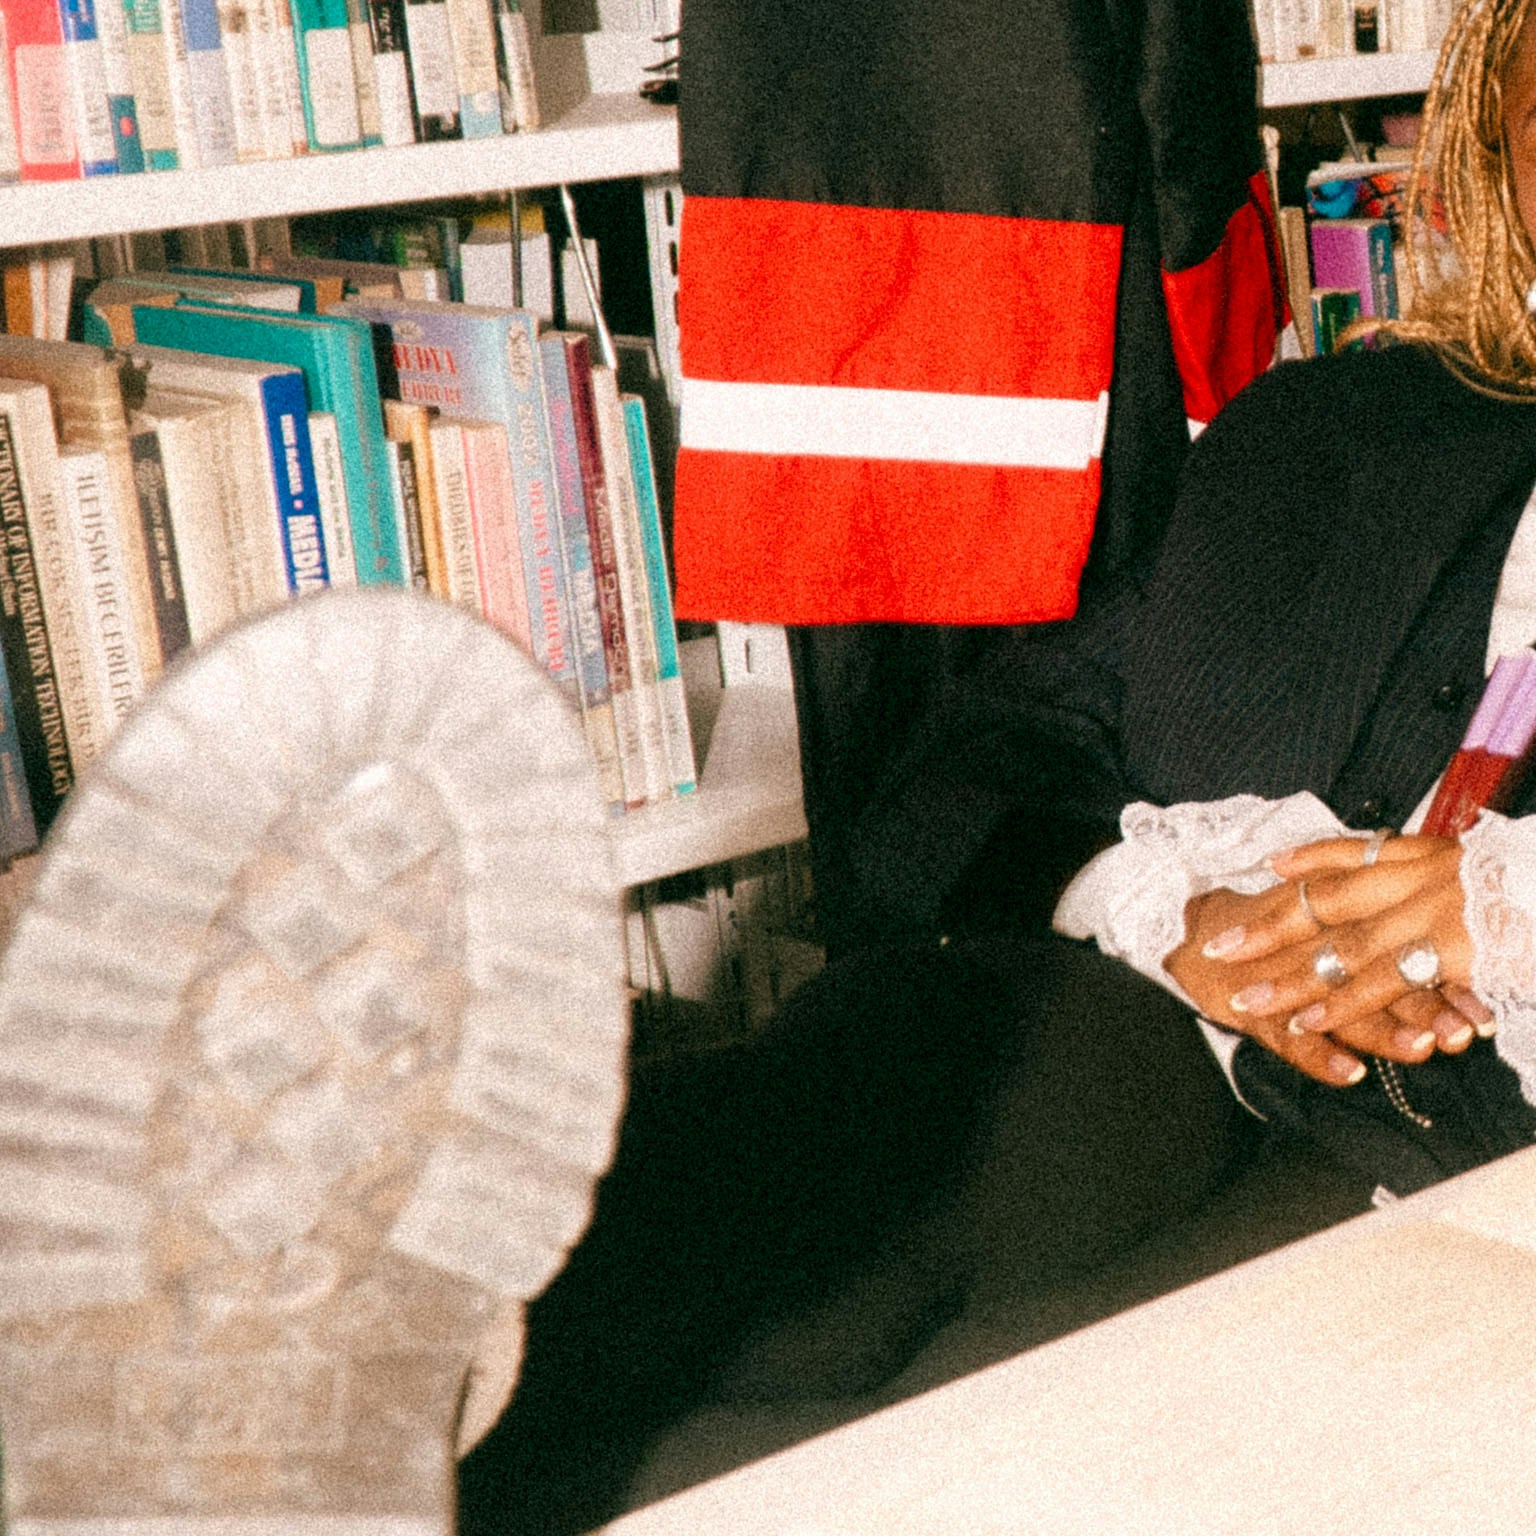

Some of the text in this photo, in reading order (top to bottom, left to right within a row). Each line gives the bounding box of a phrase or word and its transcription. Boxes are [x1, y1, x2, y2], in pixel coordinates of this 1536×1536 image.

[7, 524, 28, 548] OF
[69, 472, 113, 575] İLETİŞİM
[440, 470, 475, 553] THEORIES
[525, 479, 551, 558] MEDYA
[285, 512, 329, 595] MEDIA
[11, 552, 51, 676] INFORMATION
[34, 678, 72, 795] TECHNOLOGY
